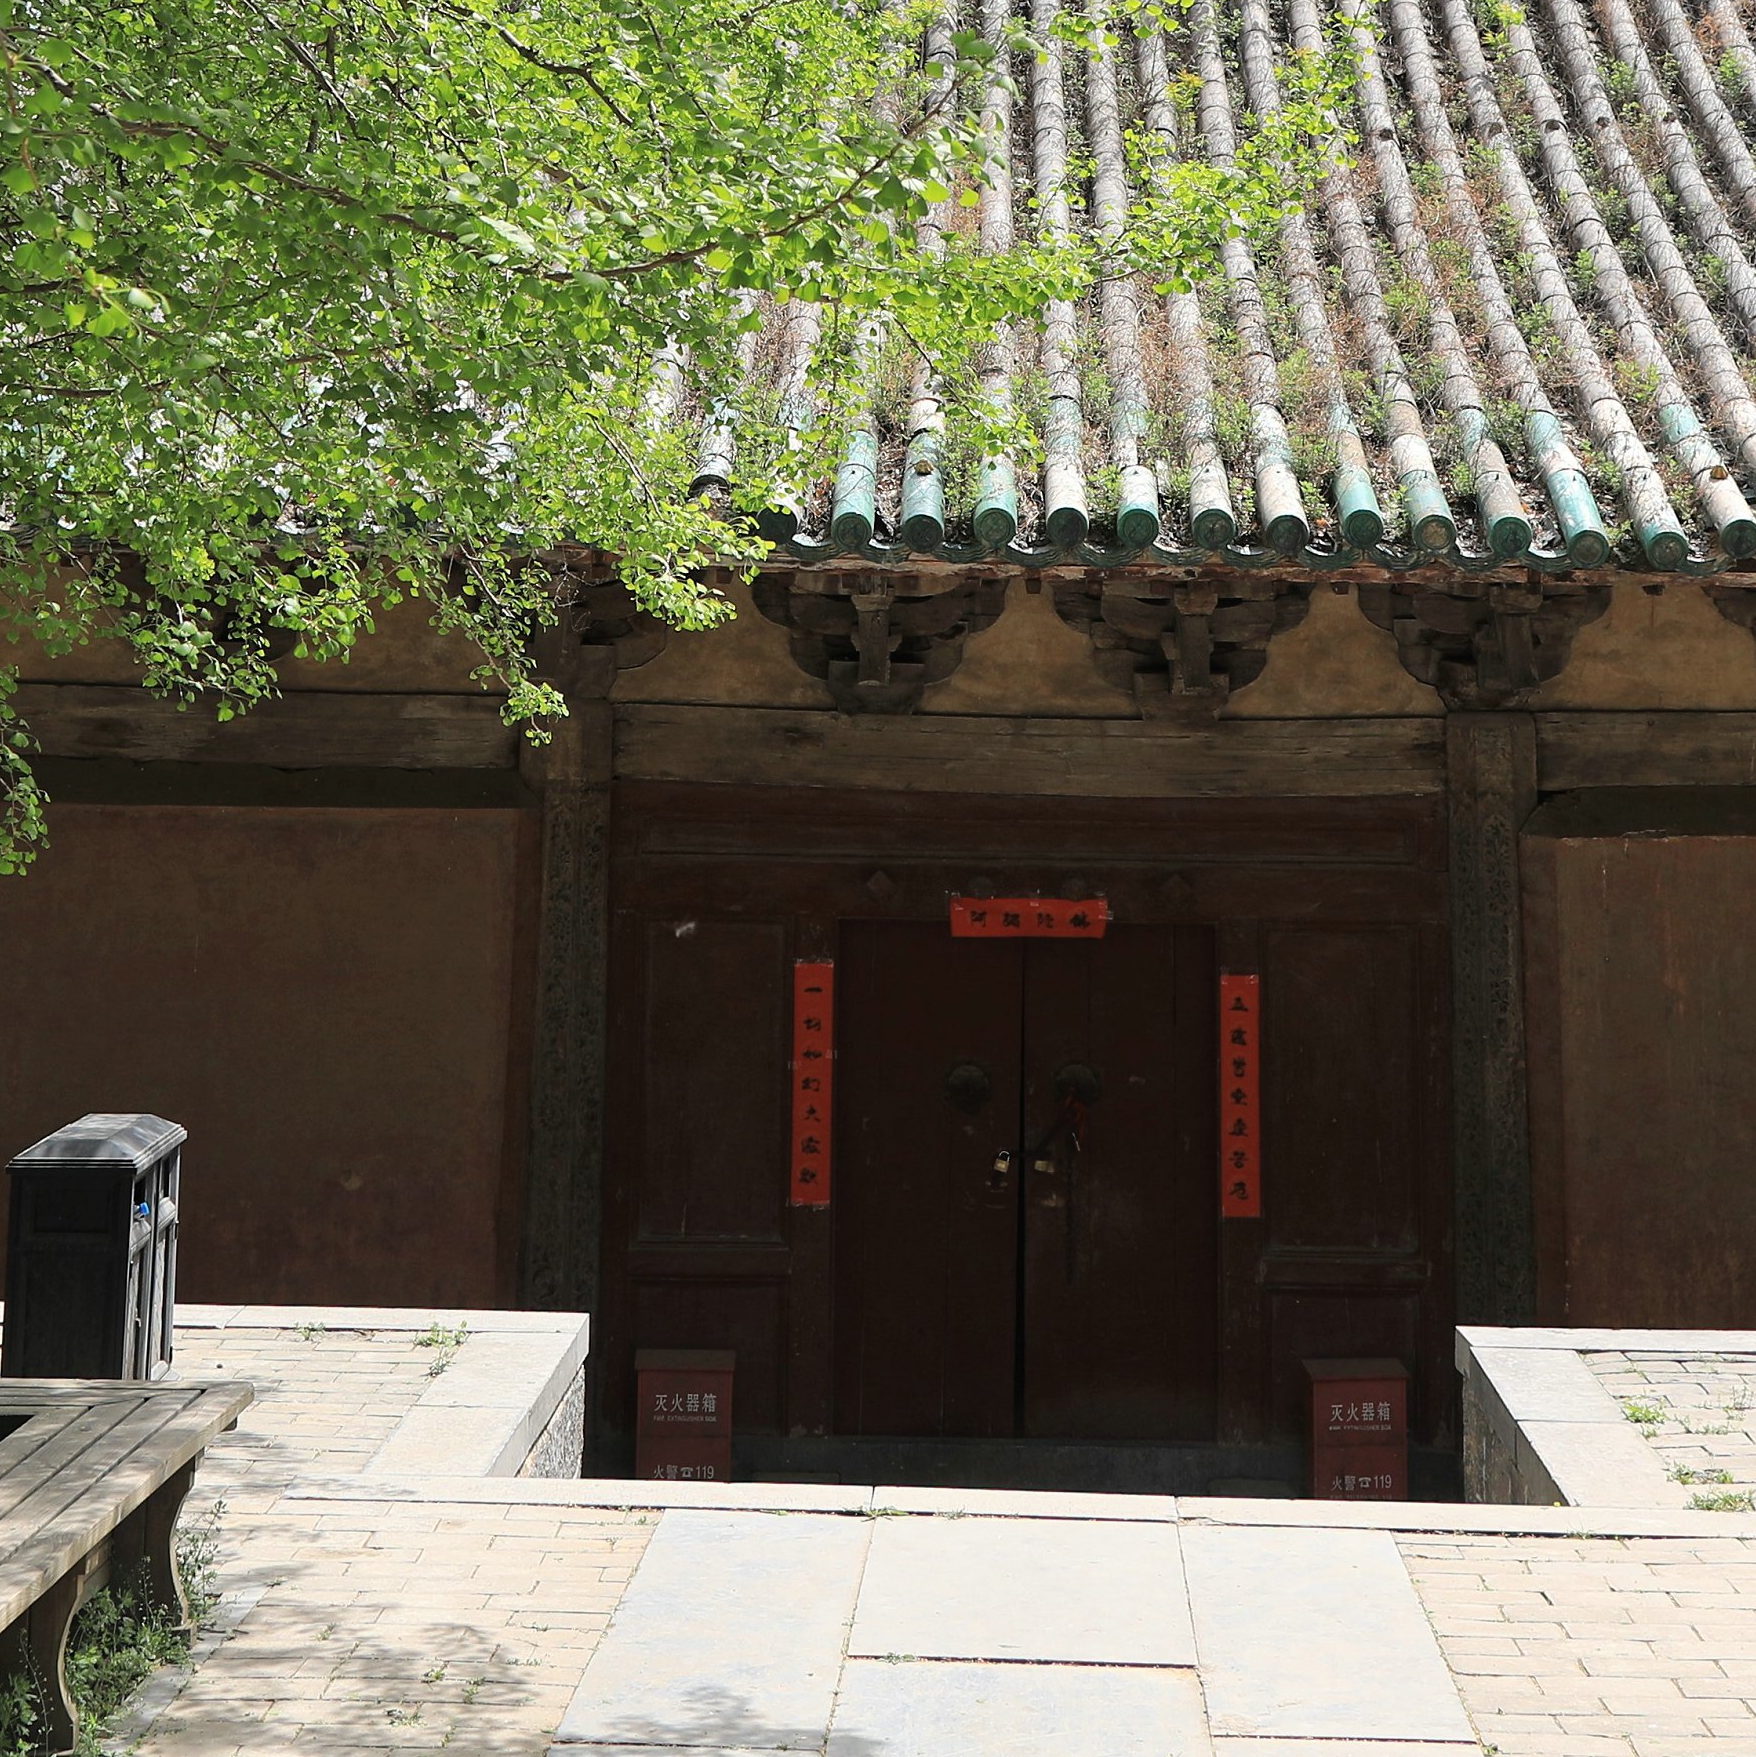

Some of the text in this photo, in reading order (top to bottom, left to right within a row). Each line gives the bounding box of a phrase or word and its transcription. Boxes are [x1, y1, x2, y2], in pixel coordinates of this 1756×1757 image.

[654, 1393, 717, 1413] 灭火器箱
[1331, 1401, 1391, 1422] 灭火器箱
[653, 1464, 714, 1479] 火警 119
[1331, 1475, 1392, 1491] 火警 119
